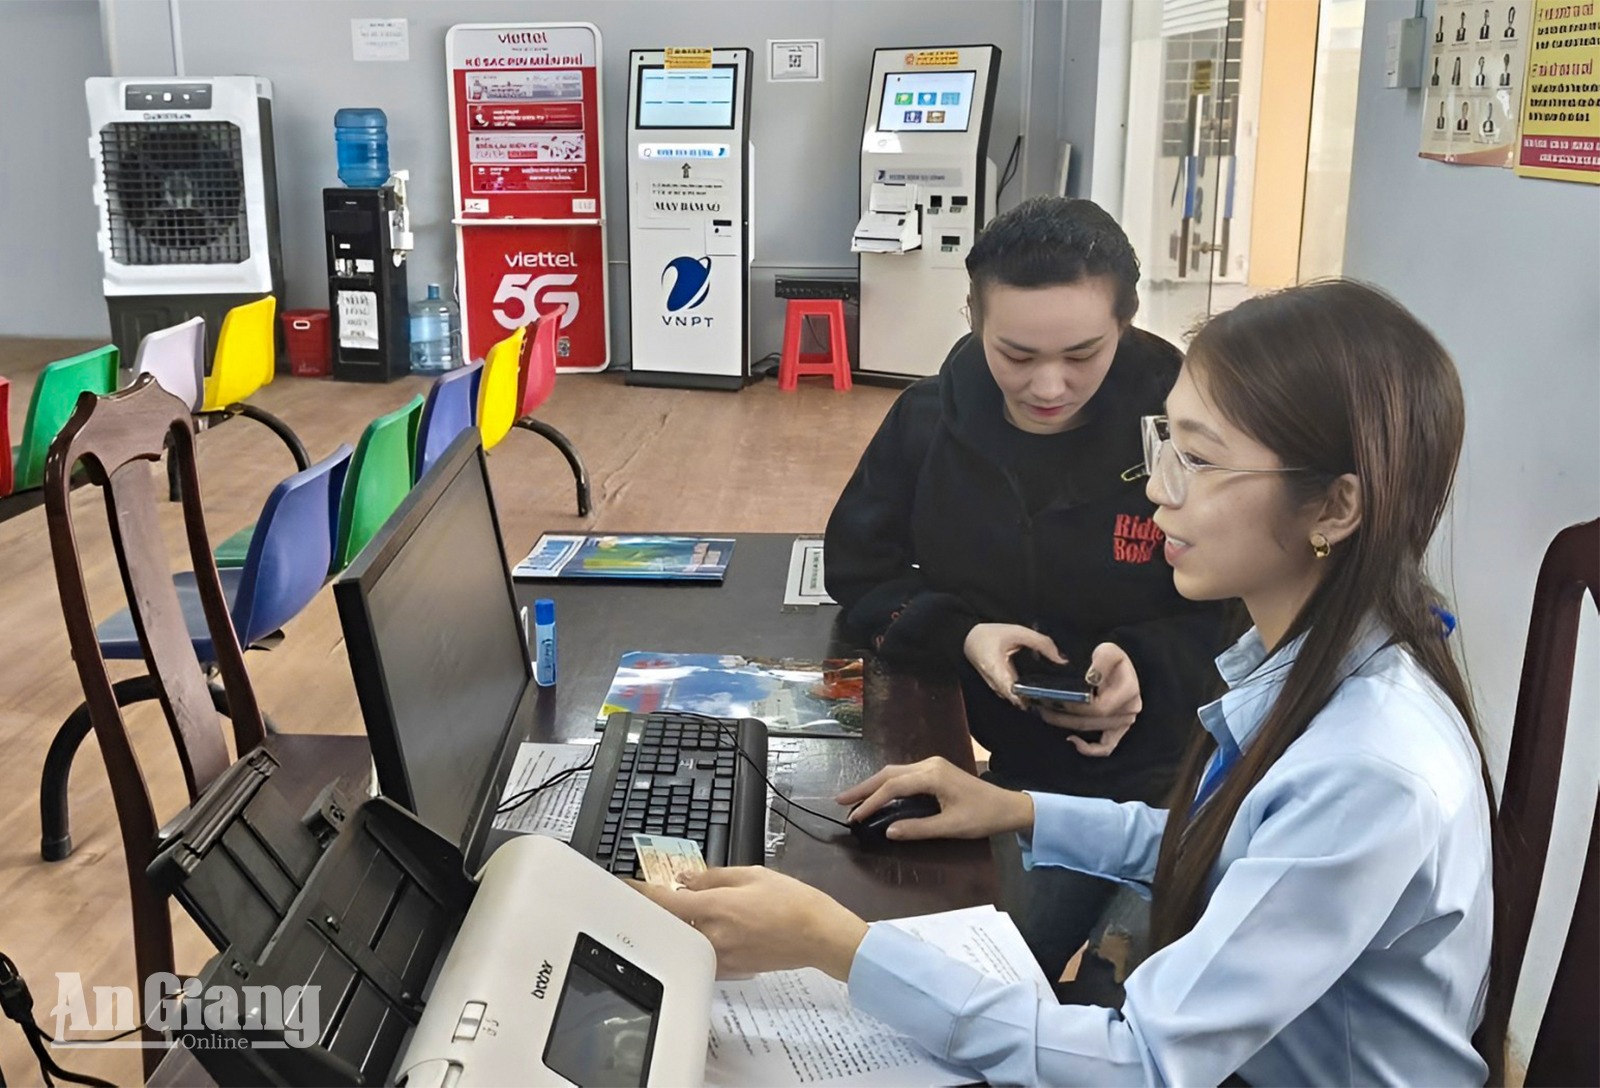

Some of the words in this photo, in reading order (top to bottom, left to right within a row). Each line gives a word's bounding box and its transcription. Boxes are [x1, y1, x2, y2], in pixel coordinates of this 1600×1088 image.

[504, 251, 578, 267] viettel
[492, 273, 580, 331] 5G
[662, 315, 714, 328] VNPT
